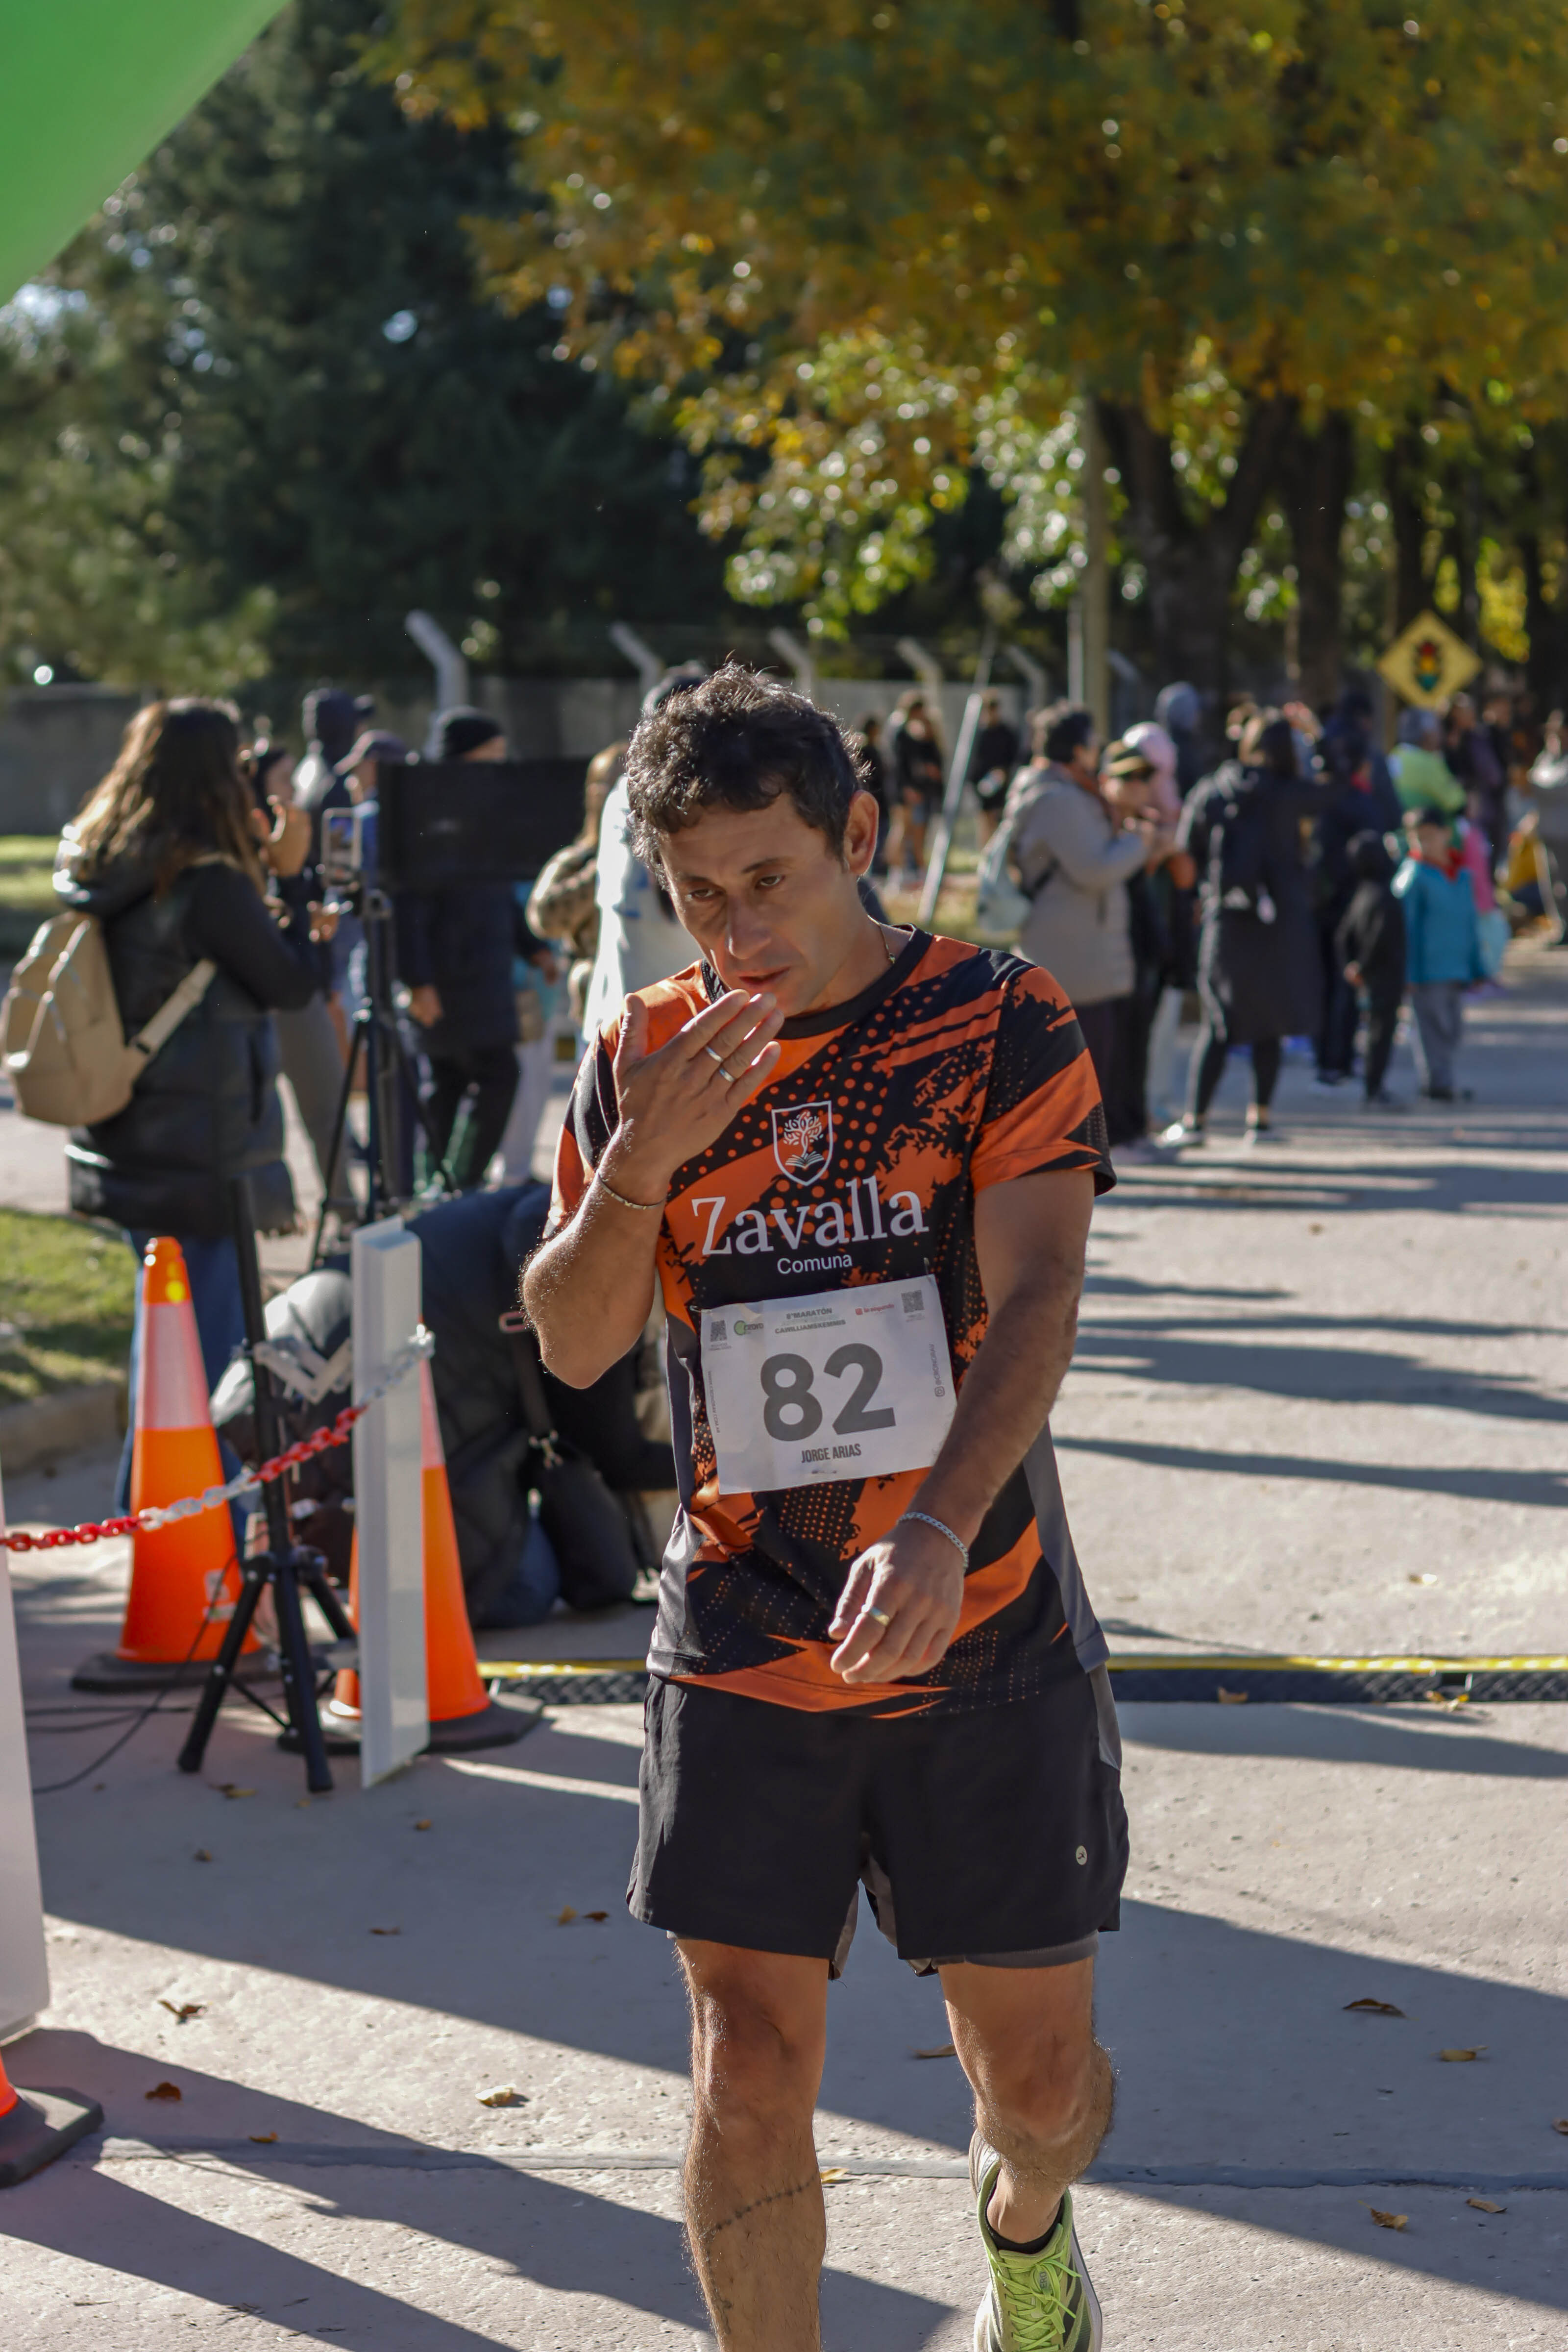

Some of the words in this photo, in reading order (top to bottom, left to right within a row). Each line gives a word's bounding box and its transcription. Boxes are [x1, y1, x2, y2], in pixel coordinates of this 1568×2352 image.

[691, 1175, 930, 1255] Zavalla
[777, 1254, 853, 1274] Comuna
[760, 1343, 897, 1442] 82
[801, 1447, 830, 1464] JORGE
[833, 1444, 862, 1459] ARIAS
